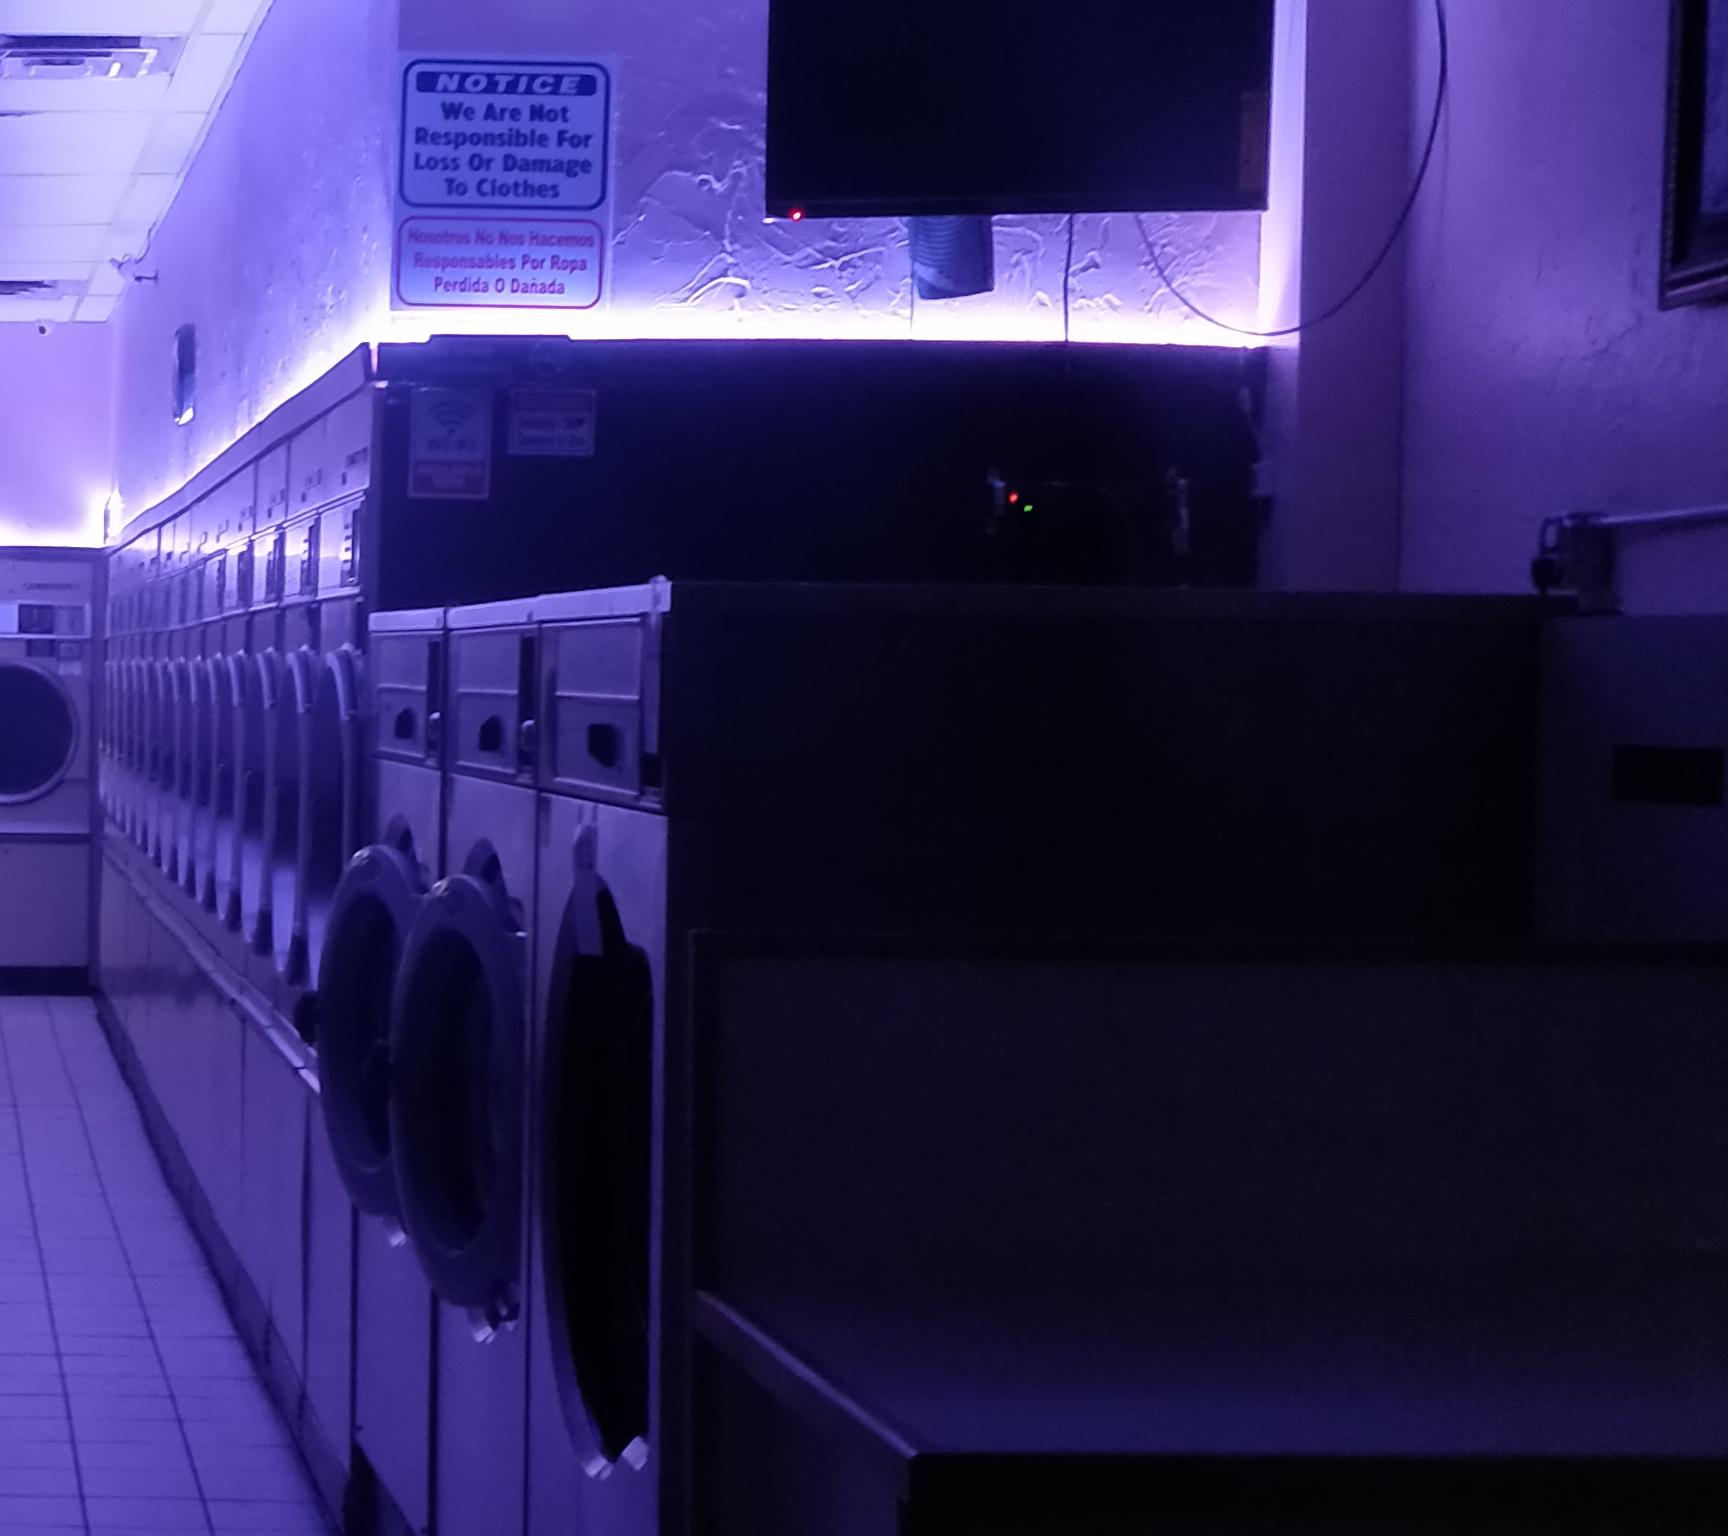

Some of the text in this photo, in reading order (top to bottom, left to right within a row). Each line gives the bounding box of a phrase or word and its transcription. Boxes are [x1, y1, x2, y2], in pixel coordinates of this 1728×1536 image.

[435, 73, 581, 95] NOTICE
[440, 102, 569, 123] We Are Not
[414, 127, 593, 149] Responsible For
[414, 152, 592, 178] Loss Or Damage
[444, 177, 560, 198] To Clothes
[408, 229, 594, 247] Nosotros No Nos Hacemos
[414, 251, 587, 273] Responsables Por Ropa
[434, 276, 489, 293] Perdida
[495, 278, 505, 293] O
